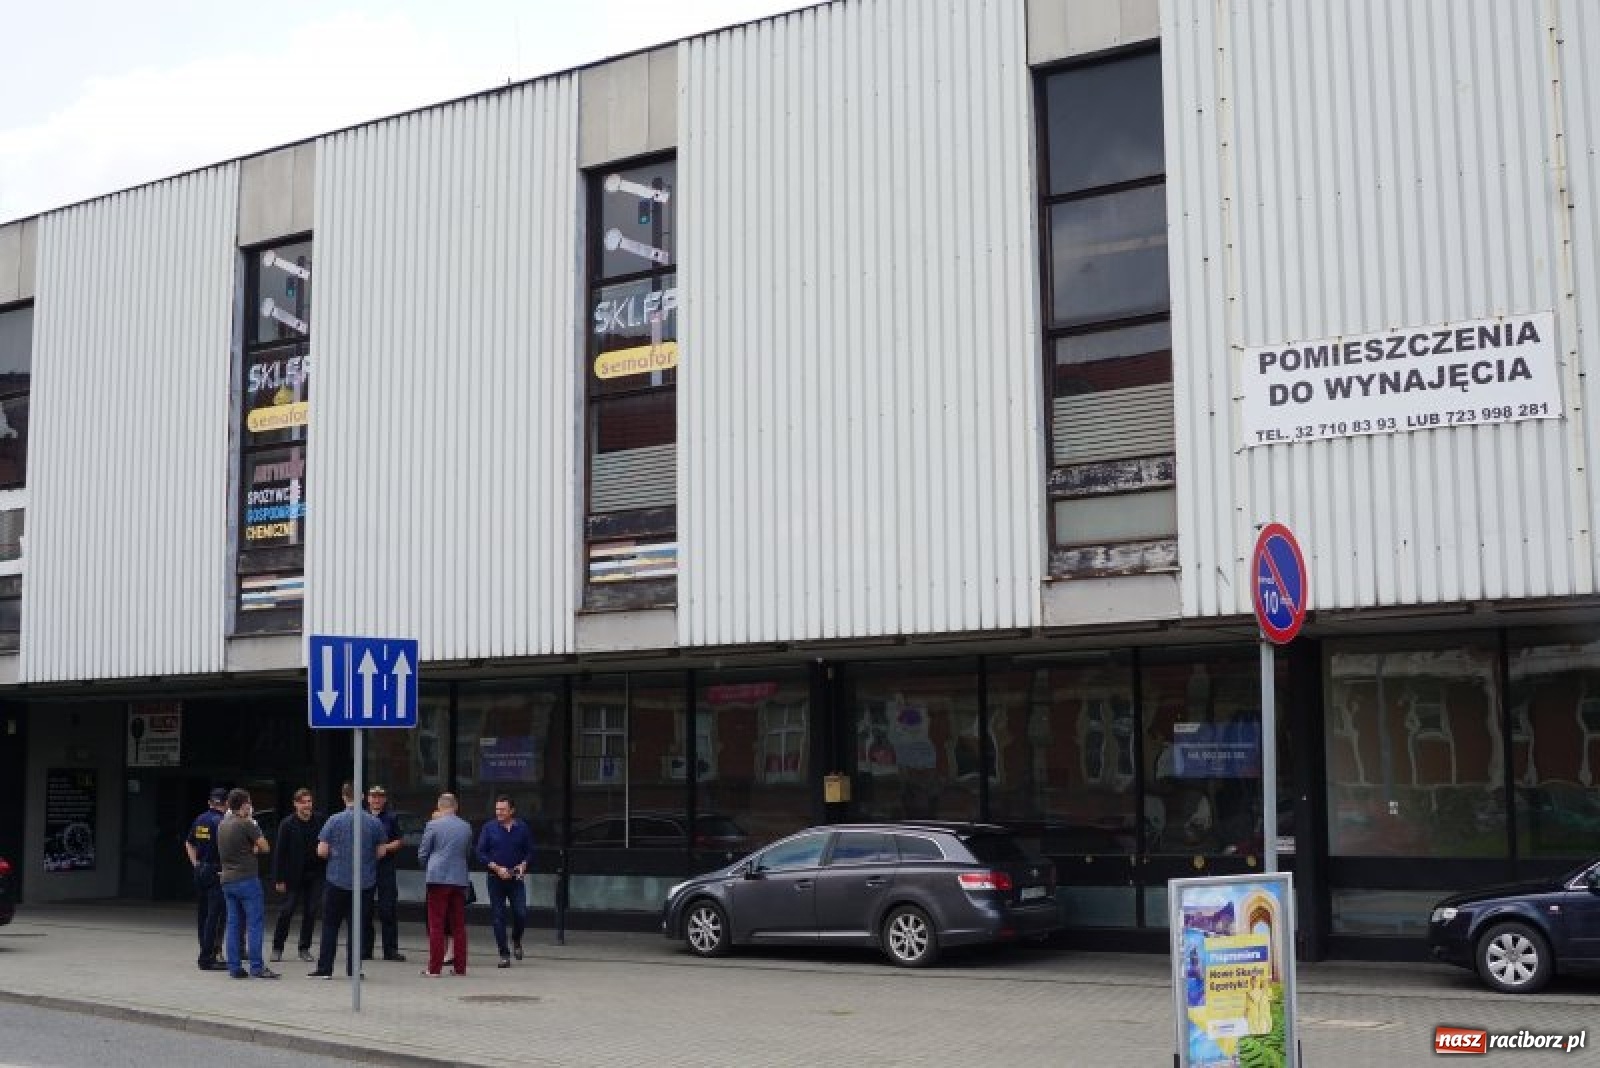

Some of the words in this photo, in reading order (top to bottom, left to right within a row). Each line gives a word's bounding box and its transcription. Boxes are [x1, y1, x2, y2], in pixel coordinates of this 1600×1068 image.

[601, 350, 675, 375] semafor
[1259, 321, 1541, 375] POMIESZCZENIA
[1269, 381, 1313, 407] DO
[1323, 356, 1533, 400] WYNAJĘCIA
[1255, 429, 1290, 442] TEL.
[1296, 425, 1313, 438] 32
[1318, 421, 1347, 434] 710
[1407, 413, 1440, 427] LUB
[1446, 409, 1476, 423] 723
[1518, 402, 1548, 417] 281
[1264, 590, 1279, 614] 10
